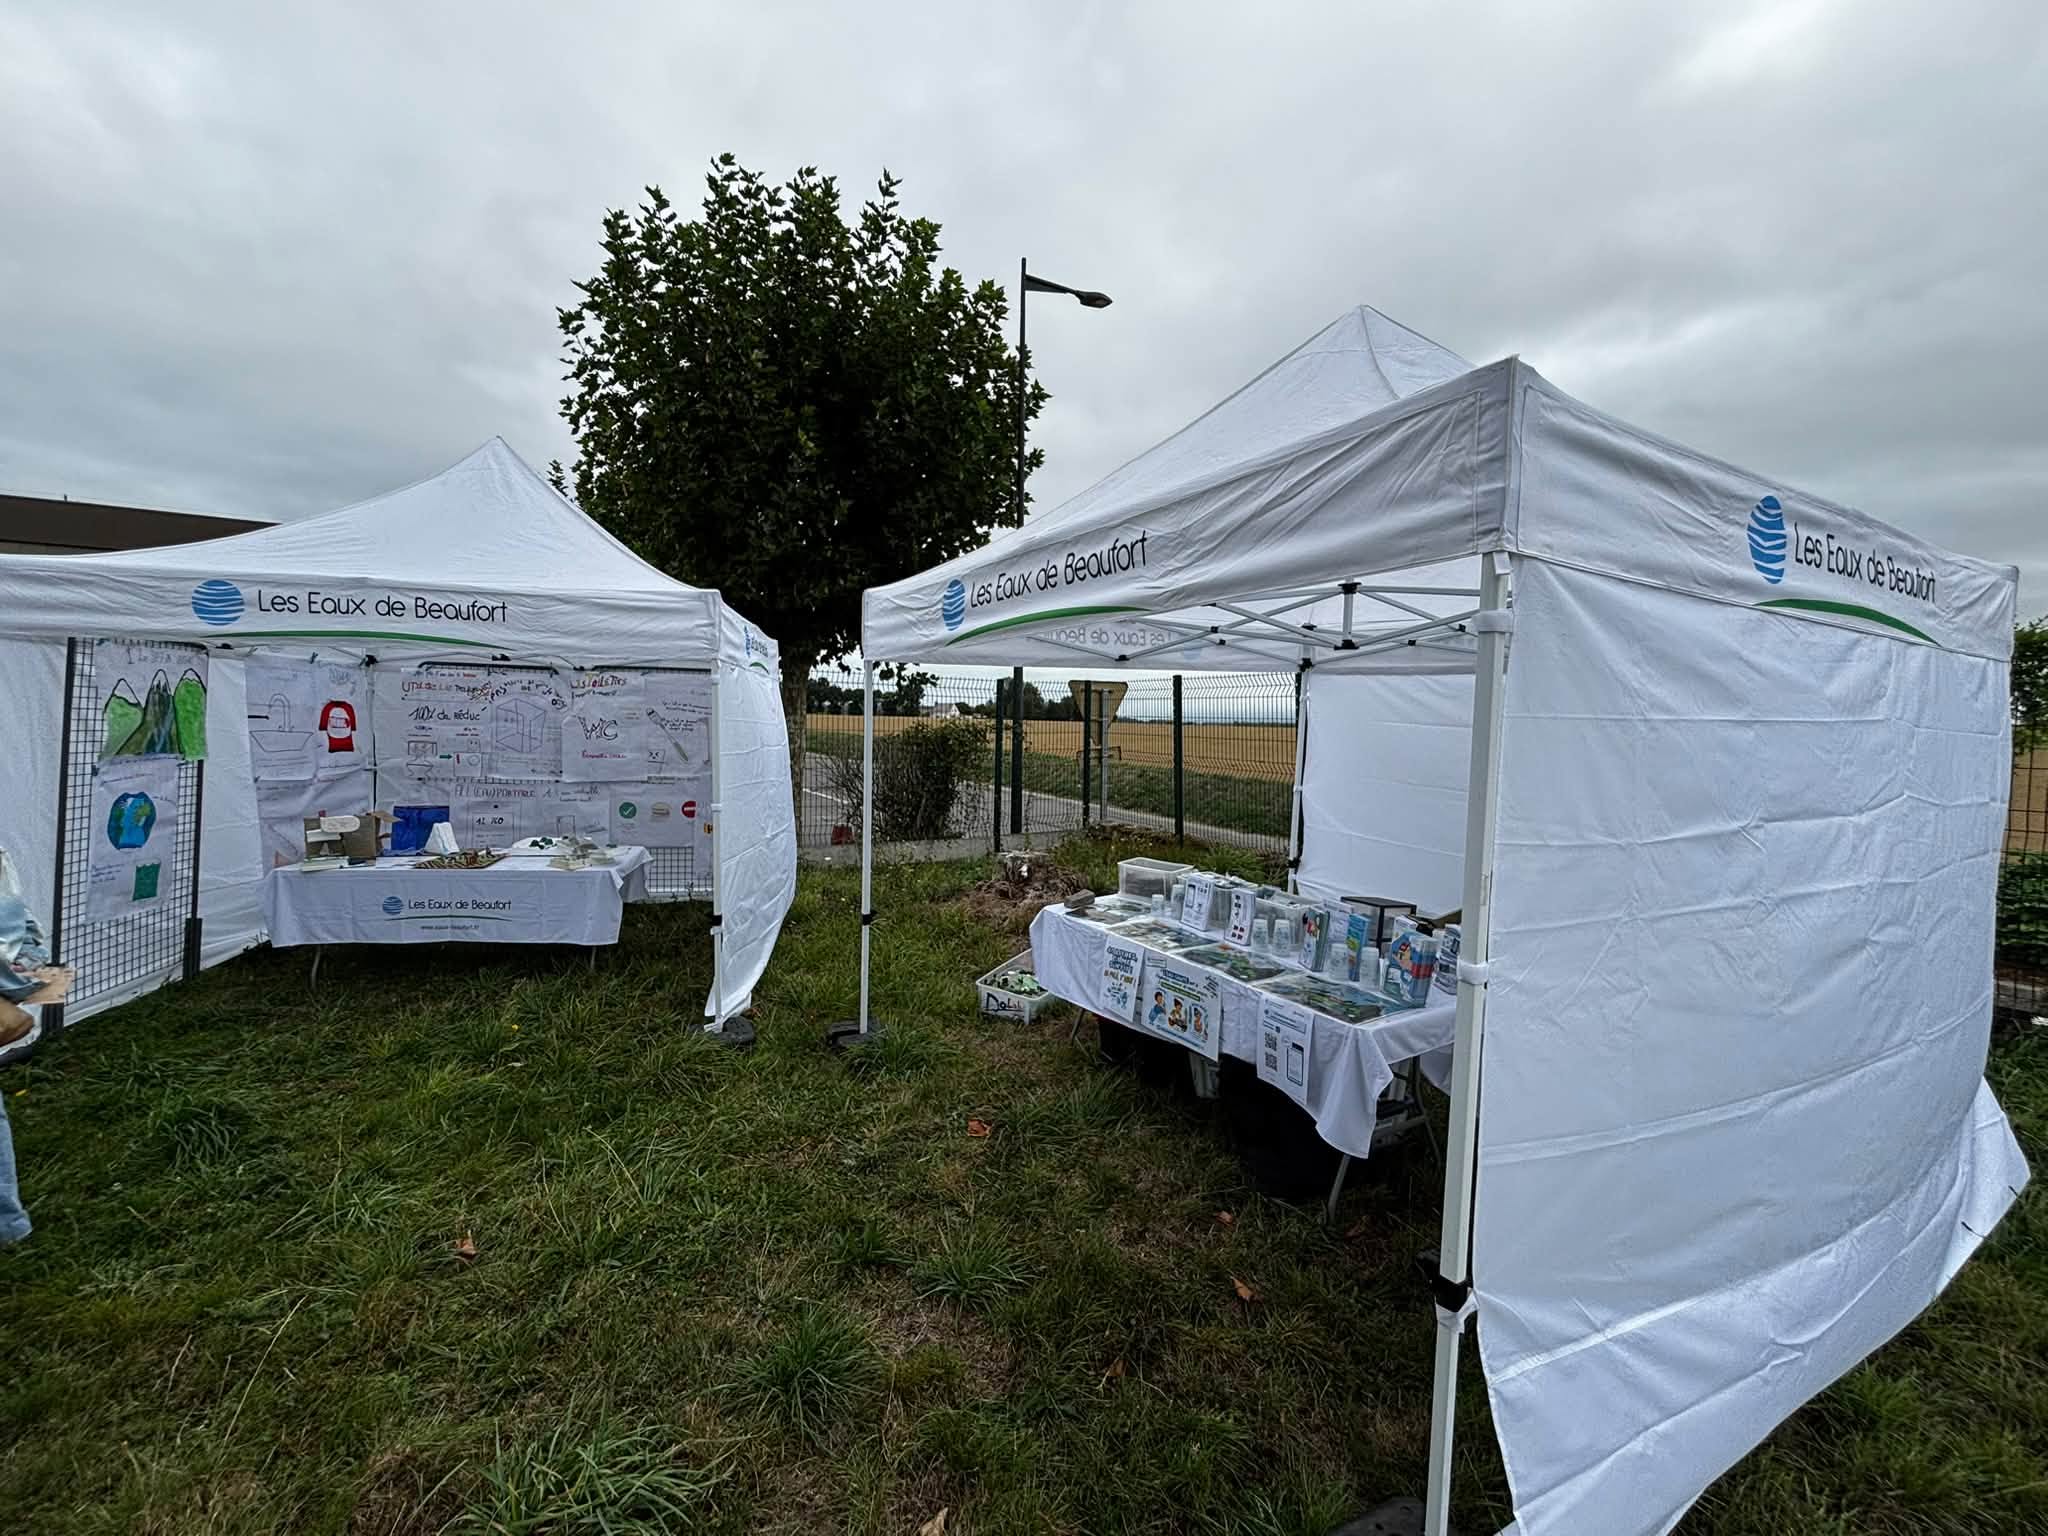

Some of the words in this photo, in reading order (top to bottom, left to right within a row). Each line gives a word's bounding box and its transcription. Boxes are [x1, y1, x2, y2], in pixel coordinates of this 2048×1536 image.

[970, 582, 992, 608] Les
[994, 571, 1032, 601] Eaux
[1036, 560, 1058, 591] de
[1064, 529, 1148, 585] Beaufort
[1793, 521, 1823, 569] Les
[1825, 533, 1863, 581] Eaux
[1866, 549, 1886, 588] de
[1886, 555, 1937, 603] Beaufort
[257, 589, 300, 613] Les
[307, 591, 367, 616] Eaux
[374, 595, 406, 617] de
[414, 596, 508, 623] Beaufort
[408, 899, 426, 910] Les
[428, 899, 453, 910] Eaux
[455, 899, 469, 910] de
[471, 899, 512, 911] Beaufort
